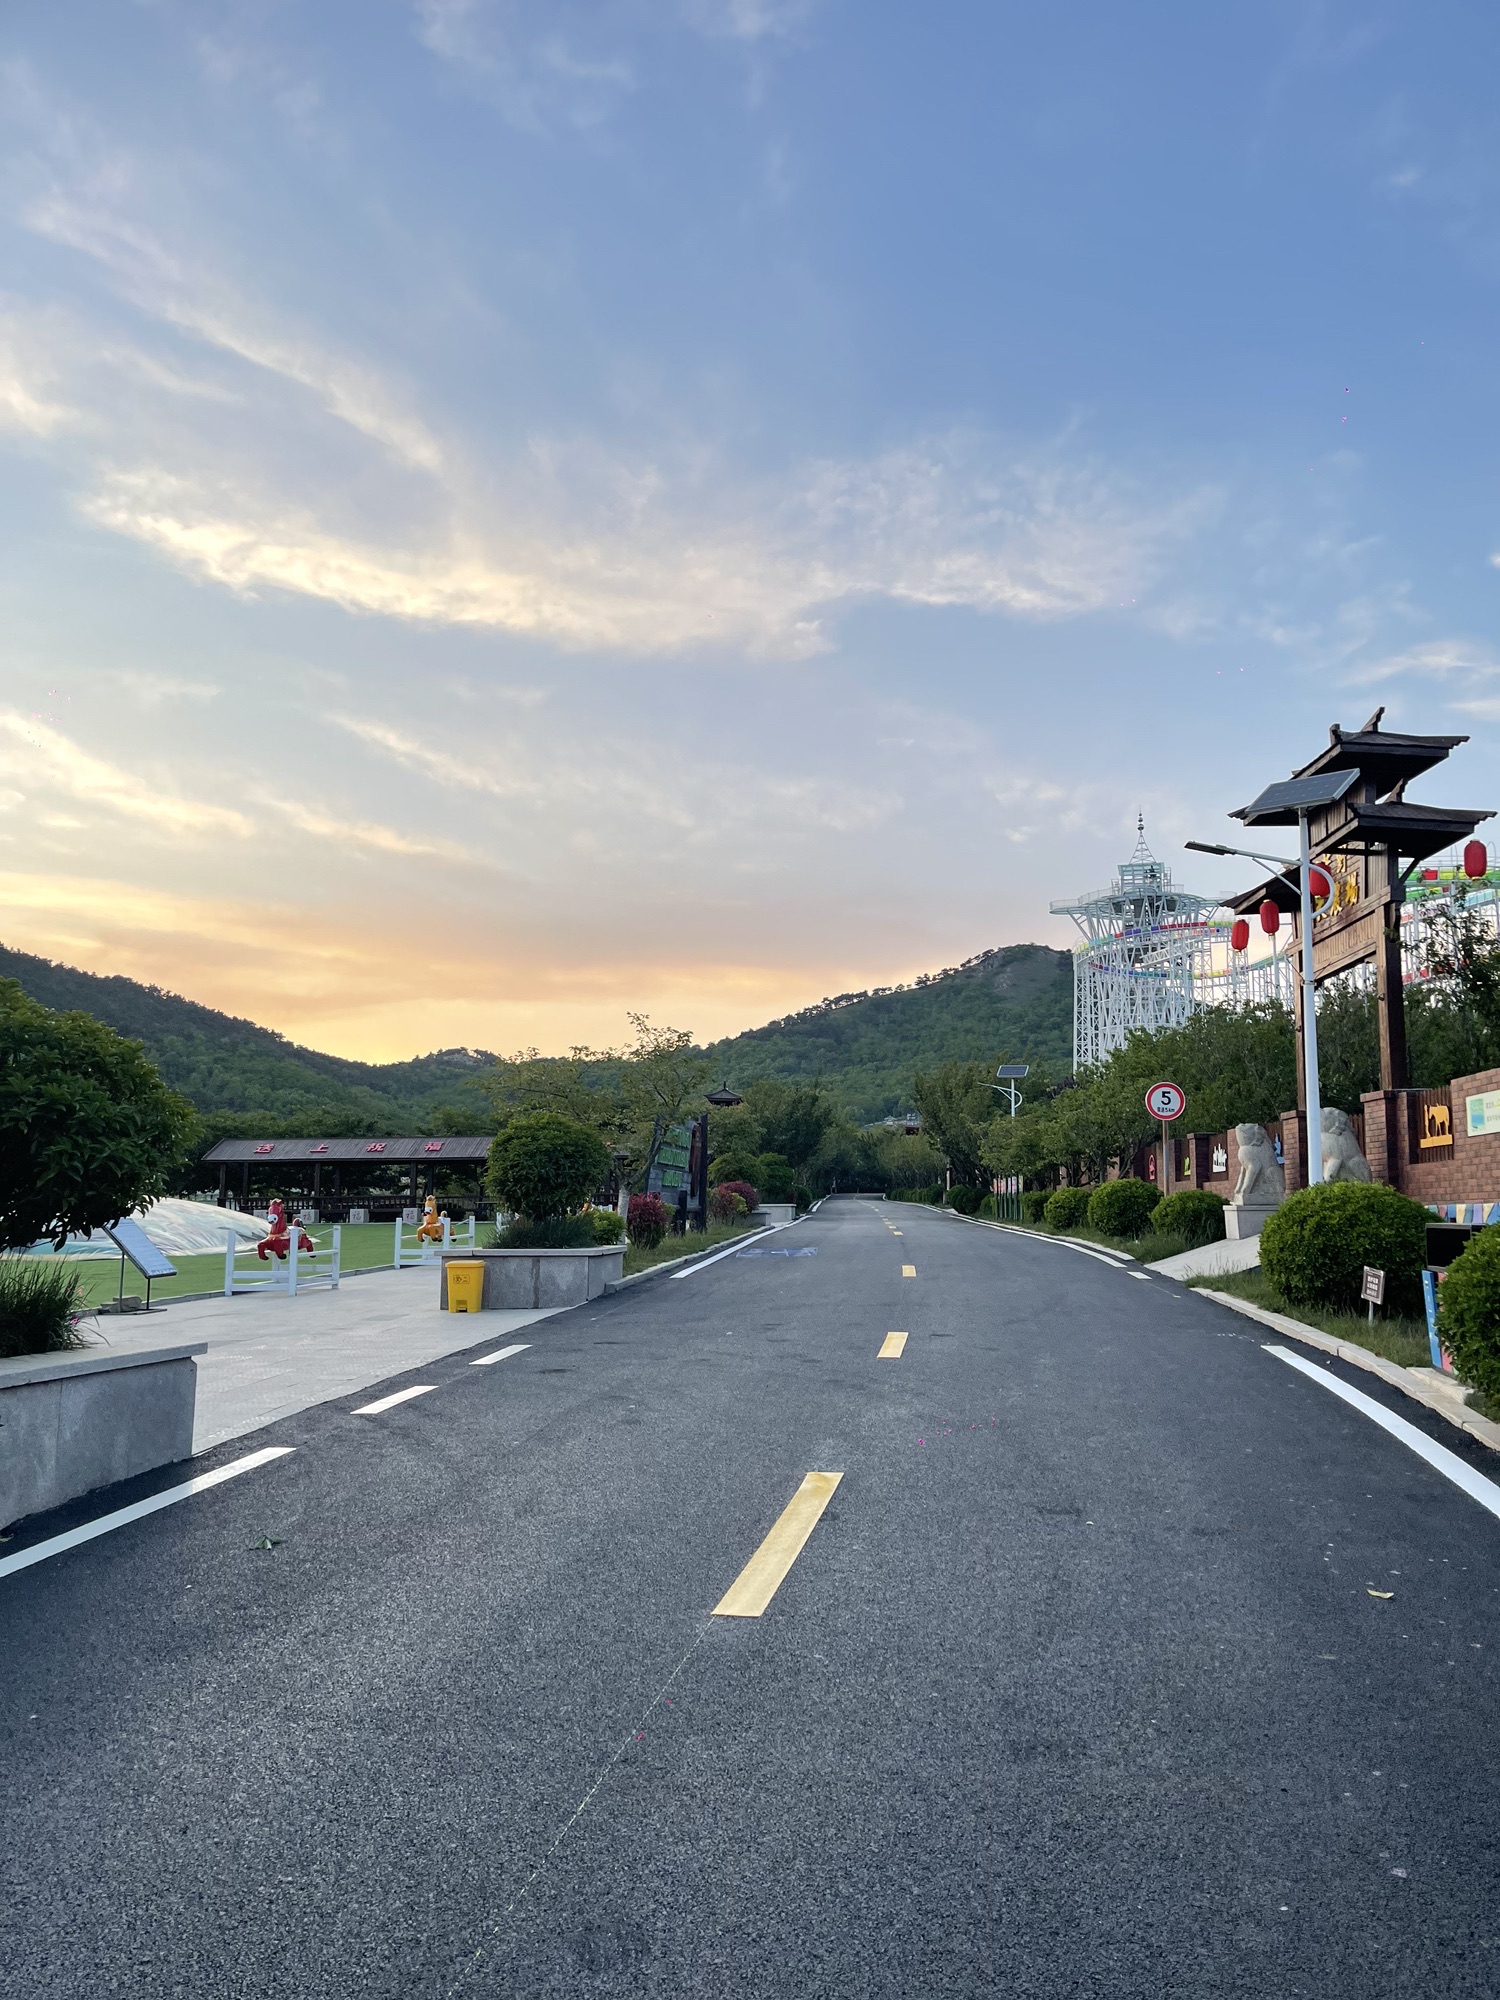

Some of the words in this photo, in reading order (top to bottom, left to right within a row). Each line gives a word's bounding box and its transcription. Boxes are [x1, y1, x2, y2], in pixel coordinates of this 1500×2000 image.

[1161, 1091, 1171, 1105] 5
[253, 1141, 443, 1153] 送上祝福
